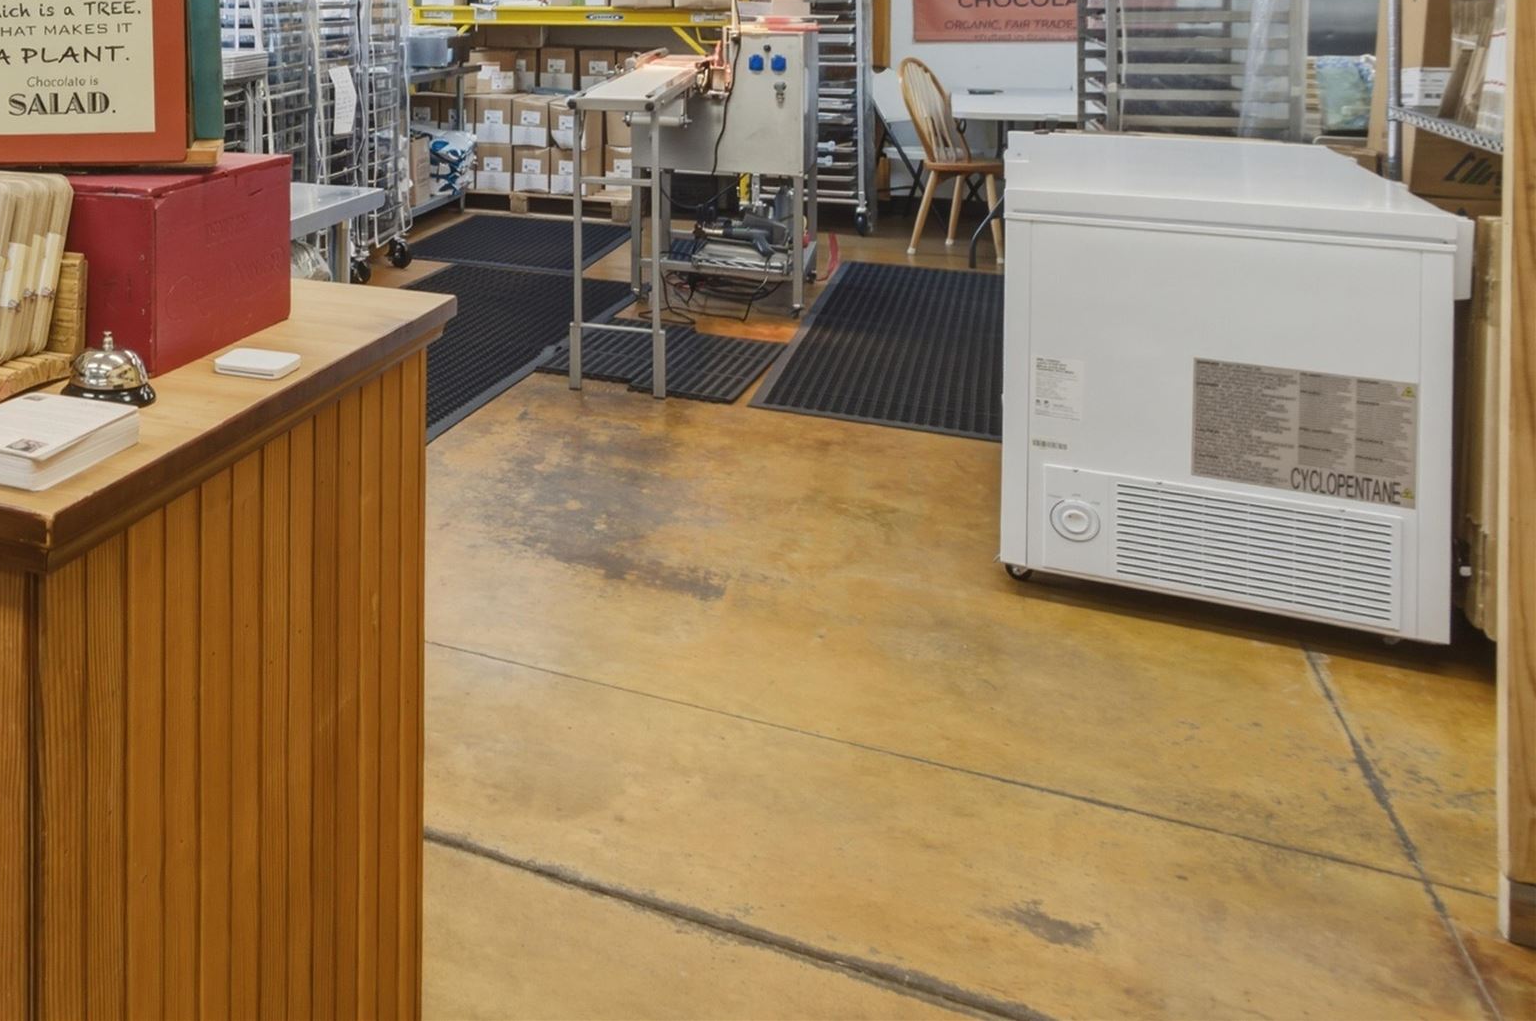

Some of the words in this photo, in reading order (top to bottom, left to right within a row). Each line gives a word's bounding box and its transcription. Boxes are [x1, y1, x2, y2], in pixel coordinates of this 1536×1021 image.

[39, 2, 55, 17] is
[63, 6, 75, 17] a
[83, 1, 141, 16] TREE.
[43, 23, 108, 36] MAKES
[116, 22, 133, 34] IT
[21, 45, 130, 64] PLANT.
[26, 75, 86, 88] Chocolate
[89, 75, 99, 86] is
[8, 91, 117, 116] SALAD.
[1290, 467, 1402, 505] CYCLOPENTANE
